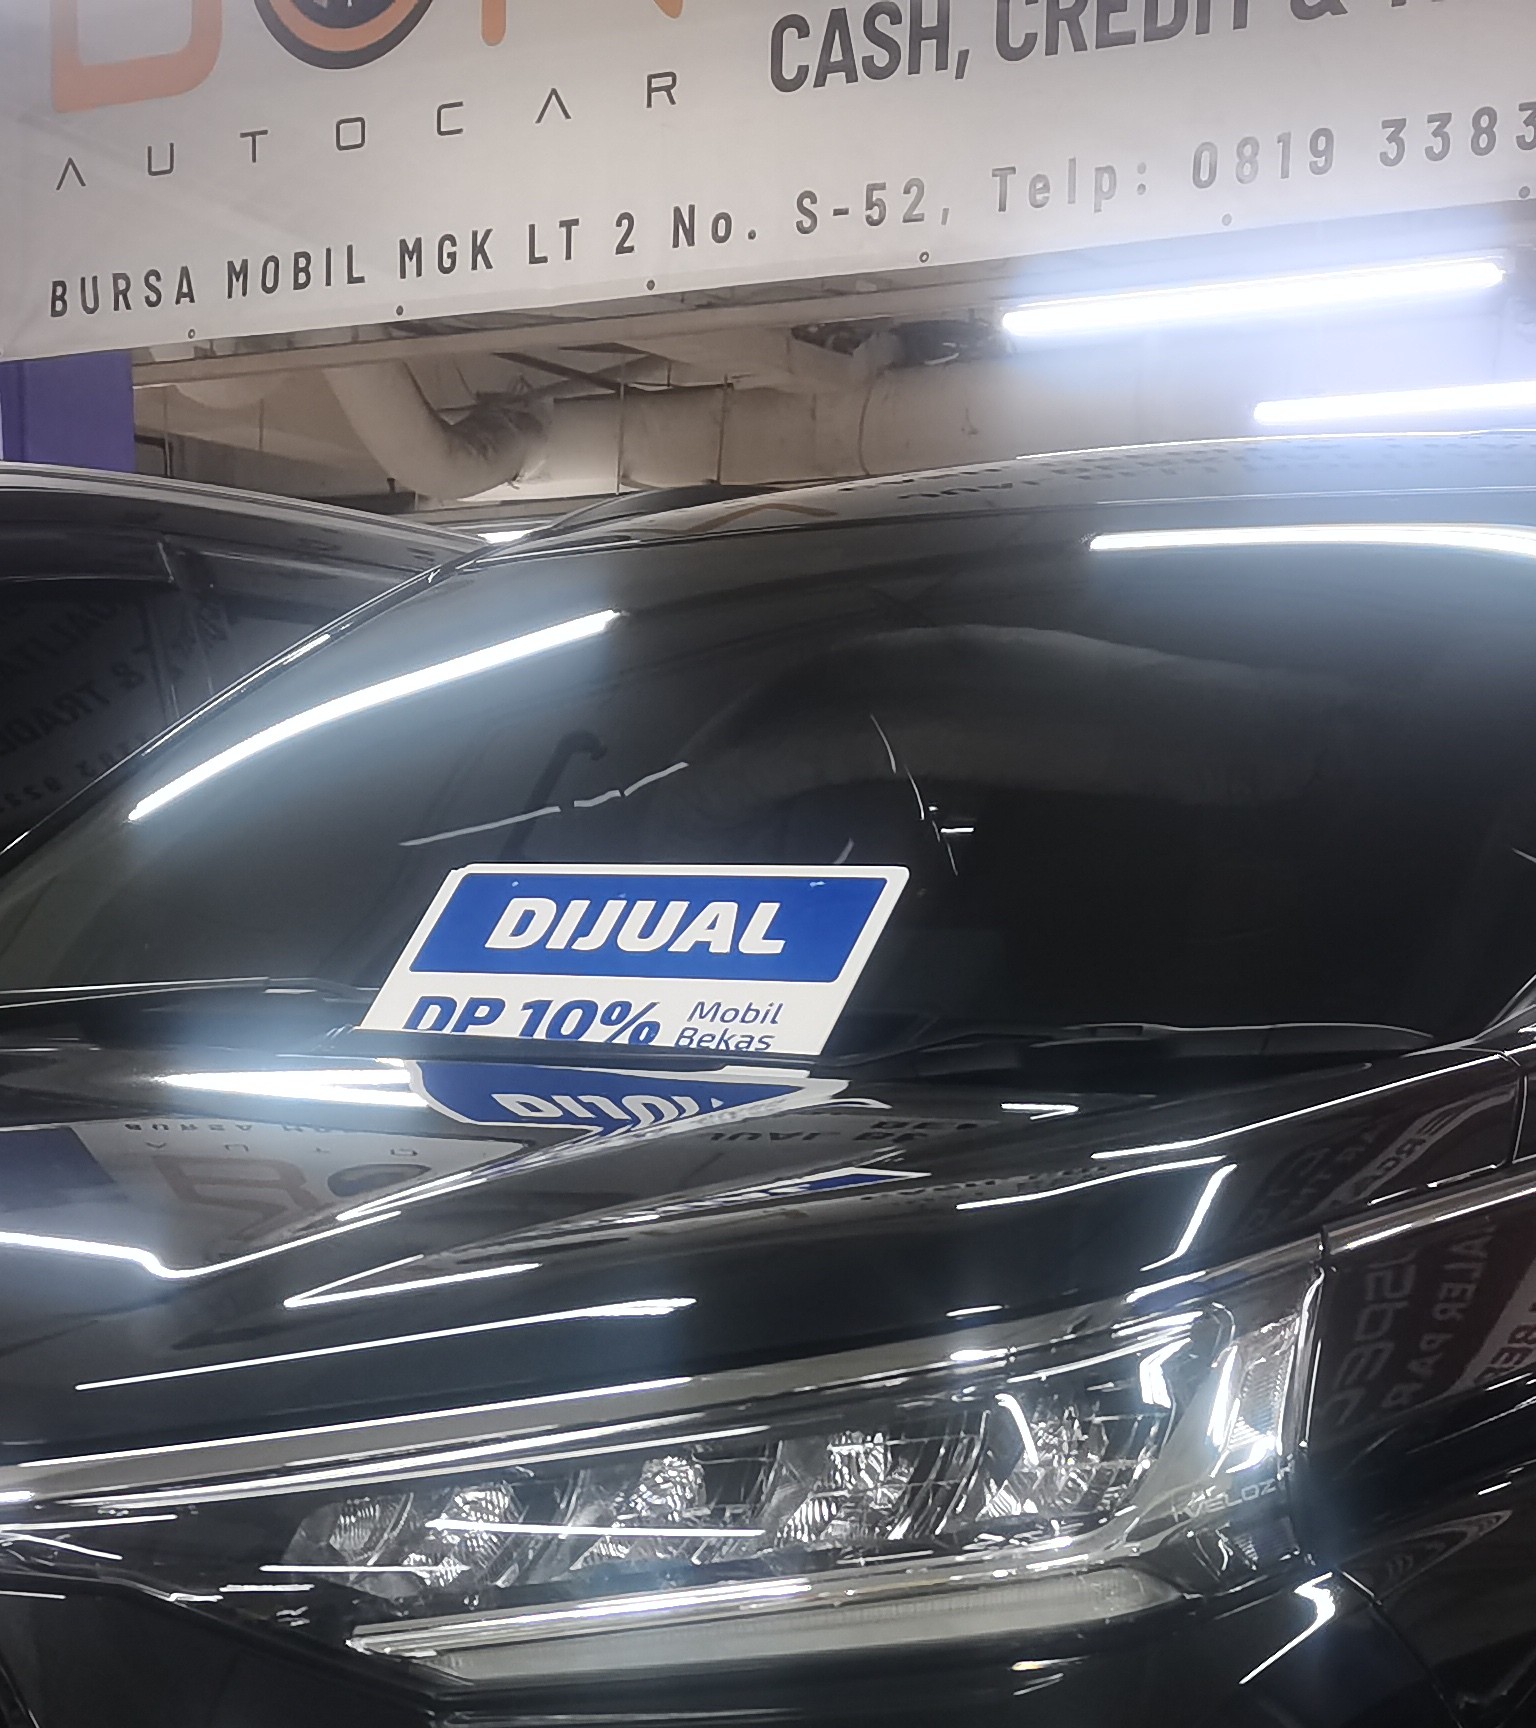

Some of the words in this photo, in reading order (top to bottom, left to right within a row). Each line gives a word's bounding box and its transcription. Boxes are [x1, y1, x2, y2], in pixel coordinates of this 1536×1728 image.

[768, 7, 970, 95] CASH,
[50, 265, 196, 318] BURSA
[226, 243, 365, 298] MOBIL
[398, 228, 494, 280] MGK
[528, 218, 580, 266] LT
[614, 212, 636, 255] 2
[671, 204, 757, 250] No.
[993, 157, 1148, 214] Telp:
[1192, 126, 1335, 191] 0819
[484, 896, 786, 954] DIJUAL
[401, 996, 505, 1034] DP
[518, 999, 660, 1046] 10%
[675, 1027, 775, 1050] Bekas
[687, 1001, 783, 1025] Mobil
